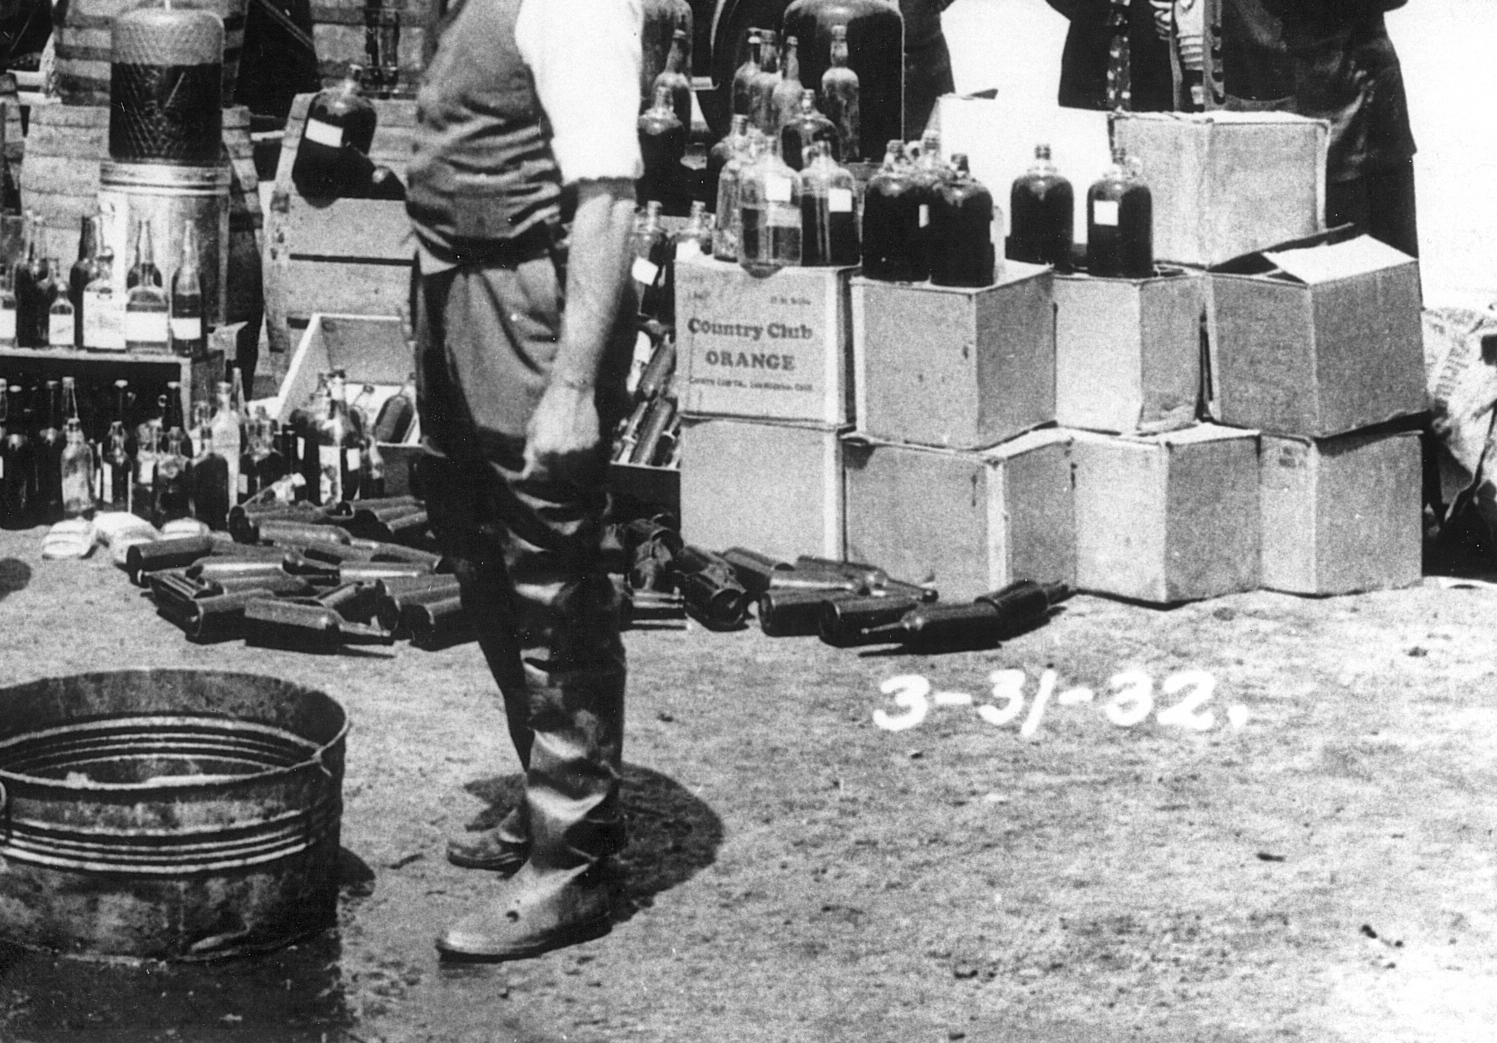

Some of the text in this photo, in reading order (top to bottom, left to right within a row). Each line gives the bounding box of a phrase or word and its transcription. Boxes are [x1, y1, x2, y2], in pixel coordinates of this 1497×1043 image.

[687, 317, 813, 341] Country Club
[704, 350, 796, 371] ORANGE
